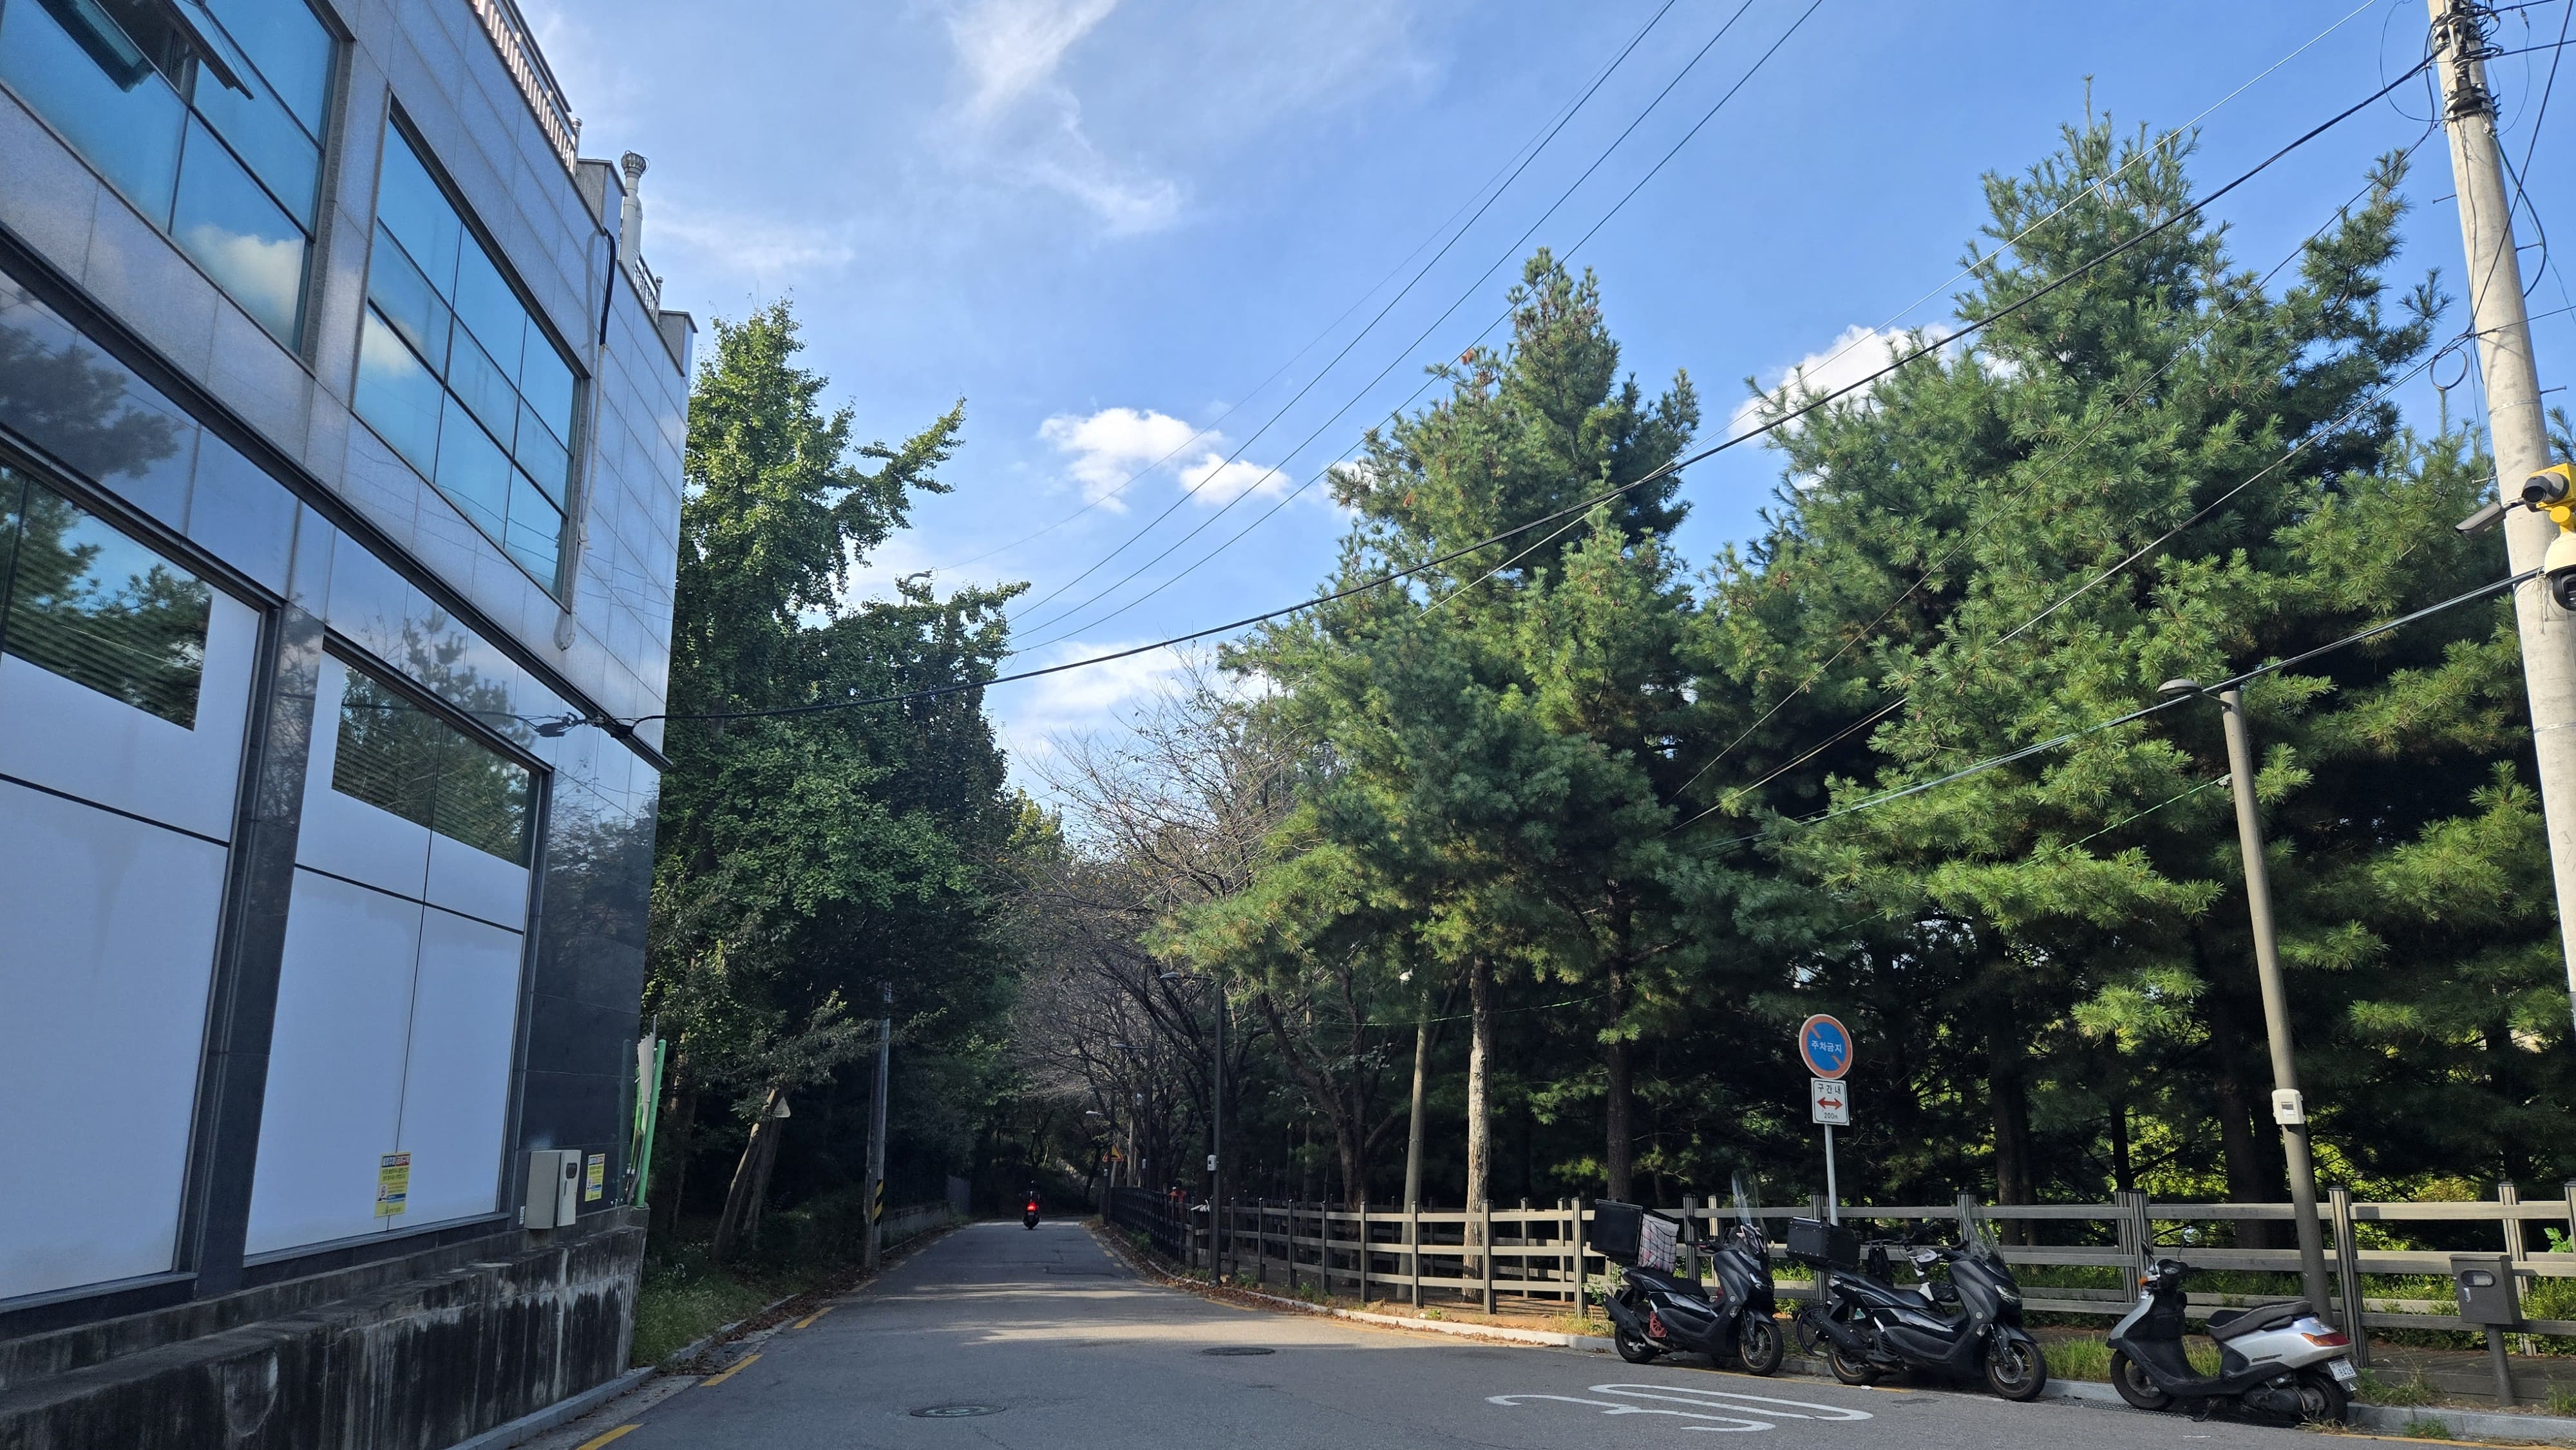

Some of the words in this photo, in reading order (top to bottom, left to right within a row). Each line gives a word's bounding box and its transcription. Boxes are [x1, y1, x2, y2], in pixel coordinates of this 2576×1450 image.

[1811, 1040, 1842, 1054] 주차금지
[1817, 1084, 1841, 1095] 구간내
[1484, 1384, 1874, 1432] 30
